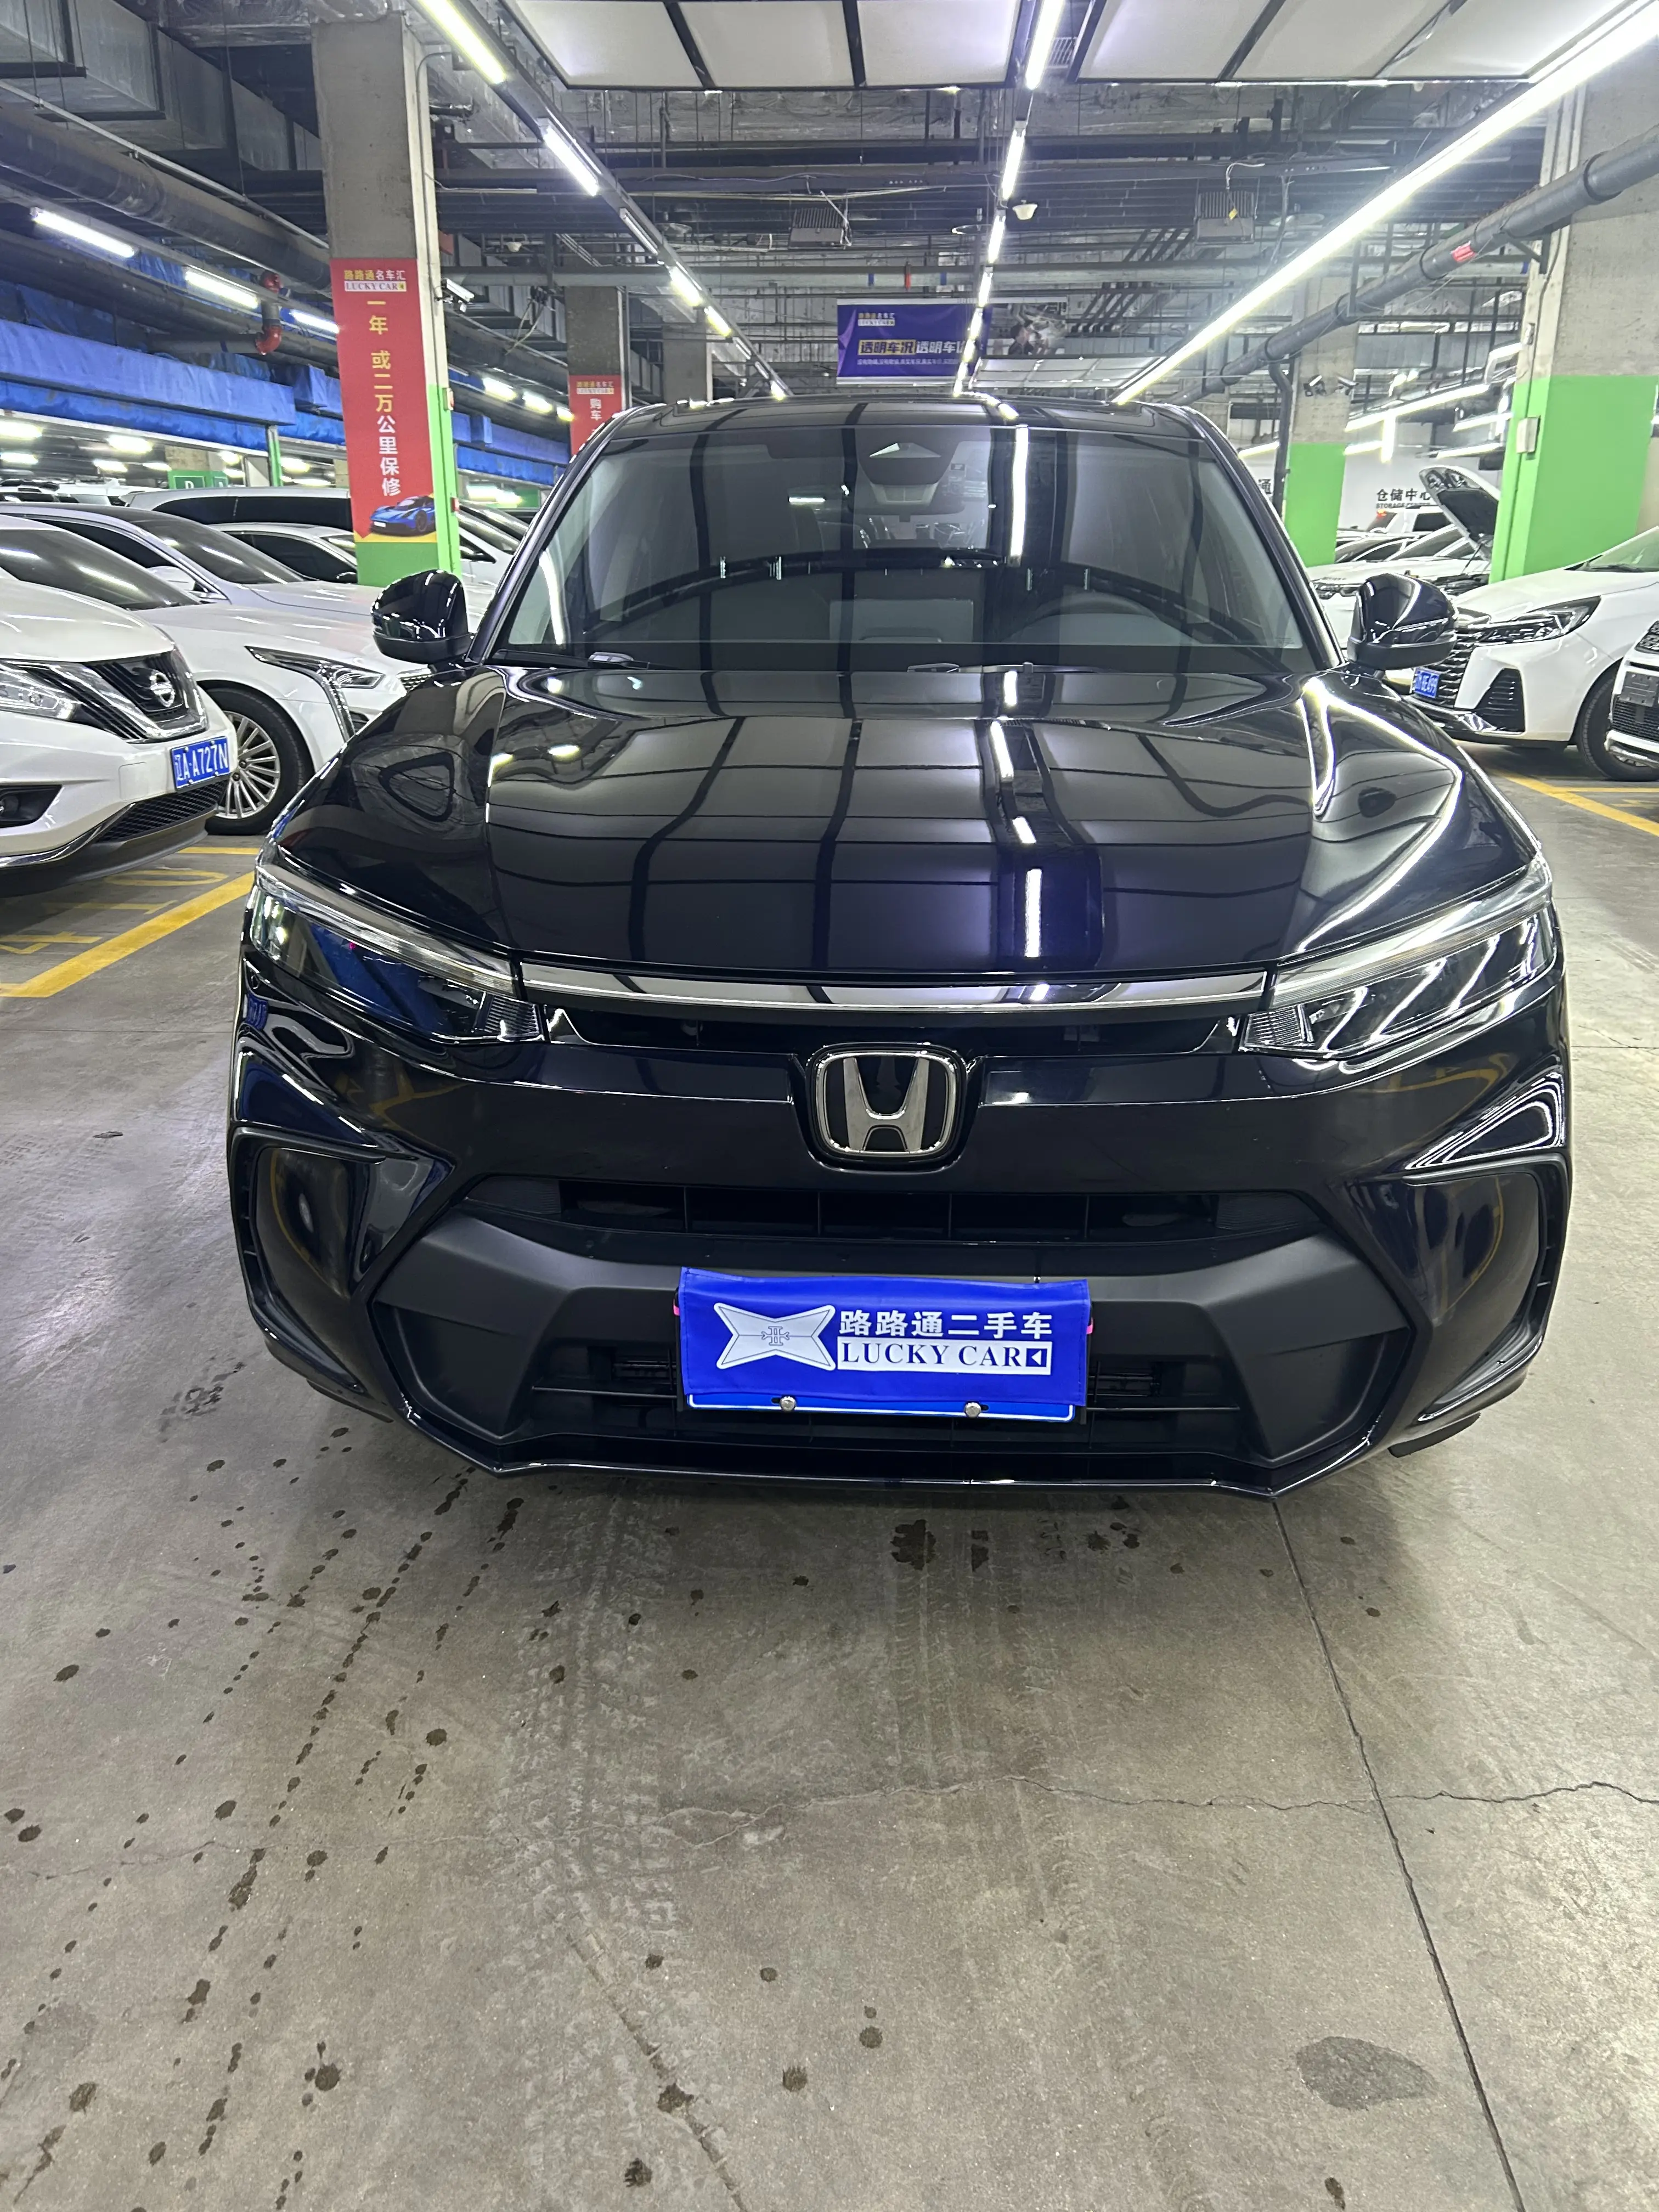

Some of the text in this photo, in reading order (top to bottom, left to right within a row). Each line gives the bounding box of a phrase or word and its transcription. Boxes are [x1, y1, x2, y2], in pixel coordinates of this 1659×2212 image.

[861, 341, 913, 354] 透明车况
[1376, 488, 1431, 501] 仓储中心
[839, 1310, 1052, 1339] 路路通二手车
[842, 1342, 1022, 1368] LUCKY CAR
